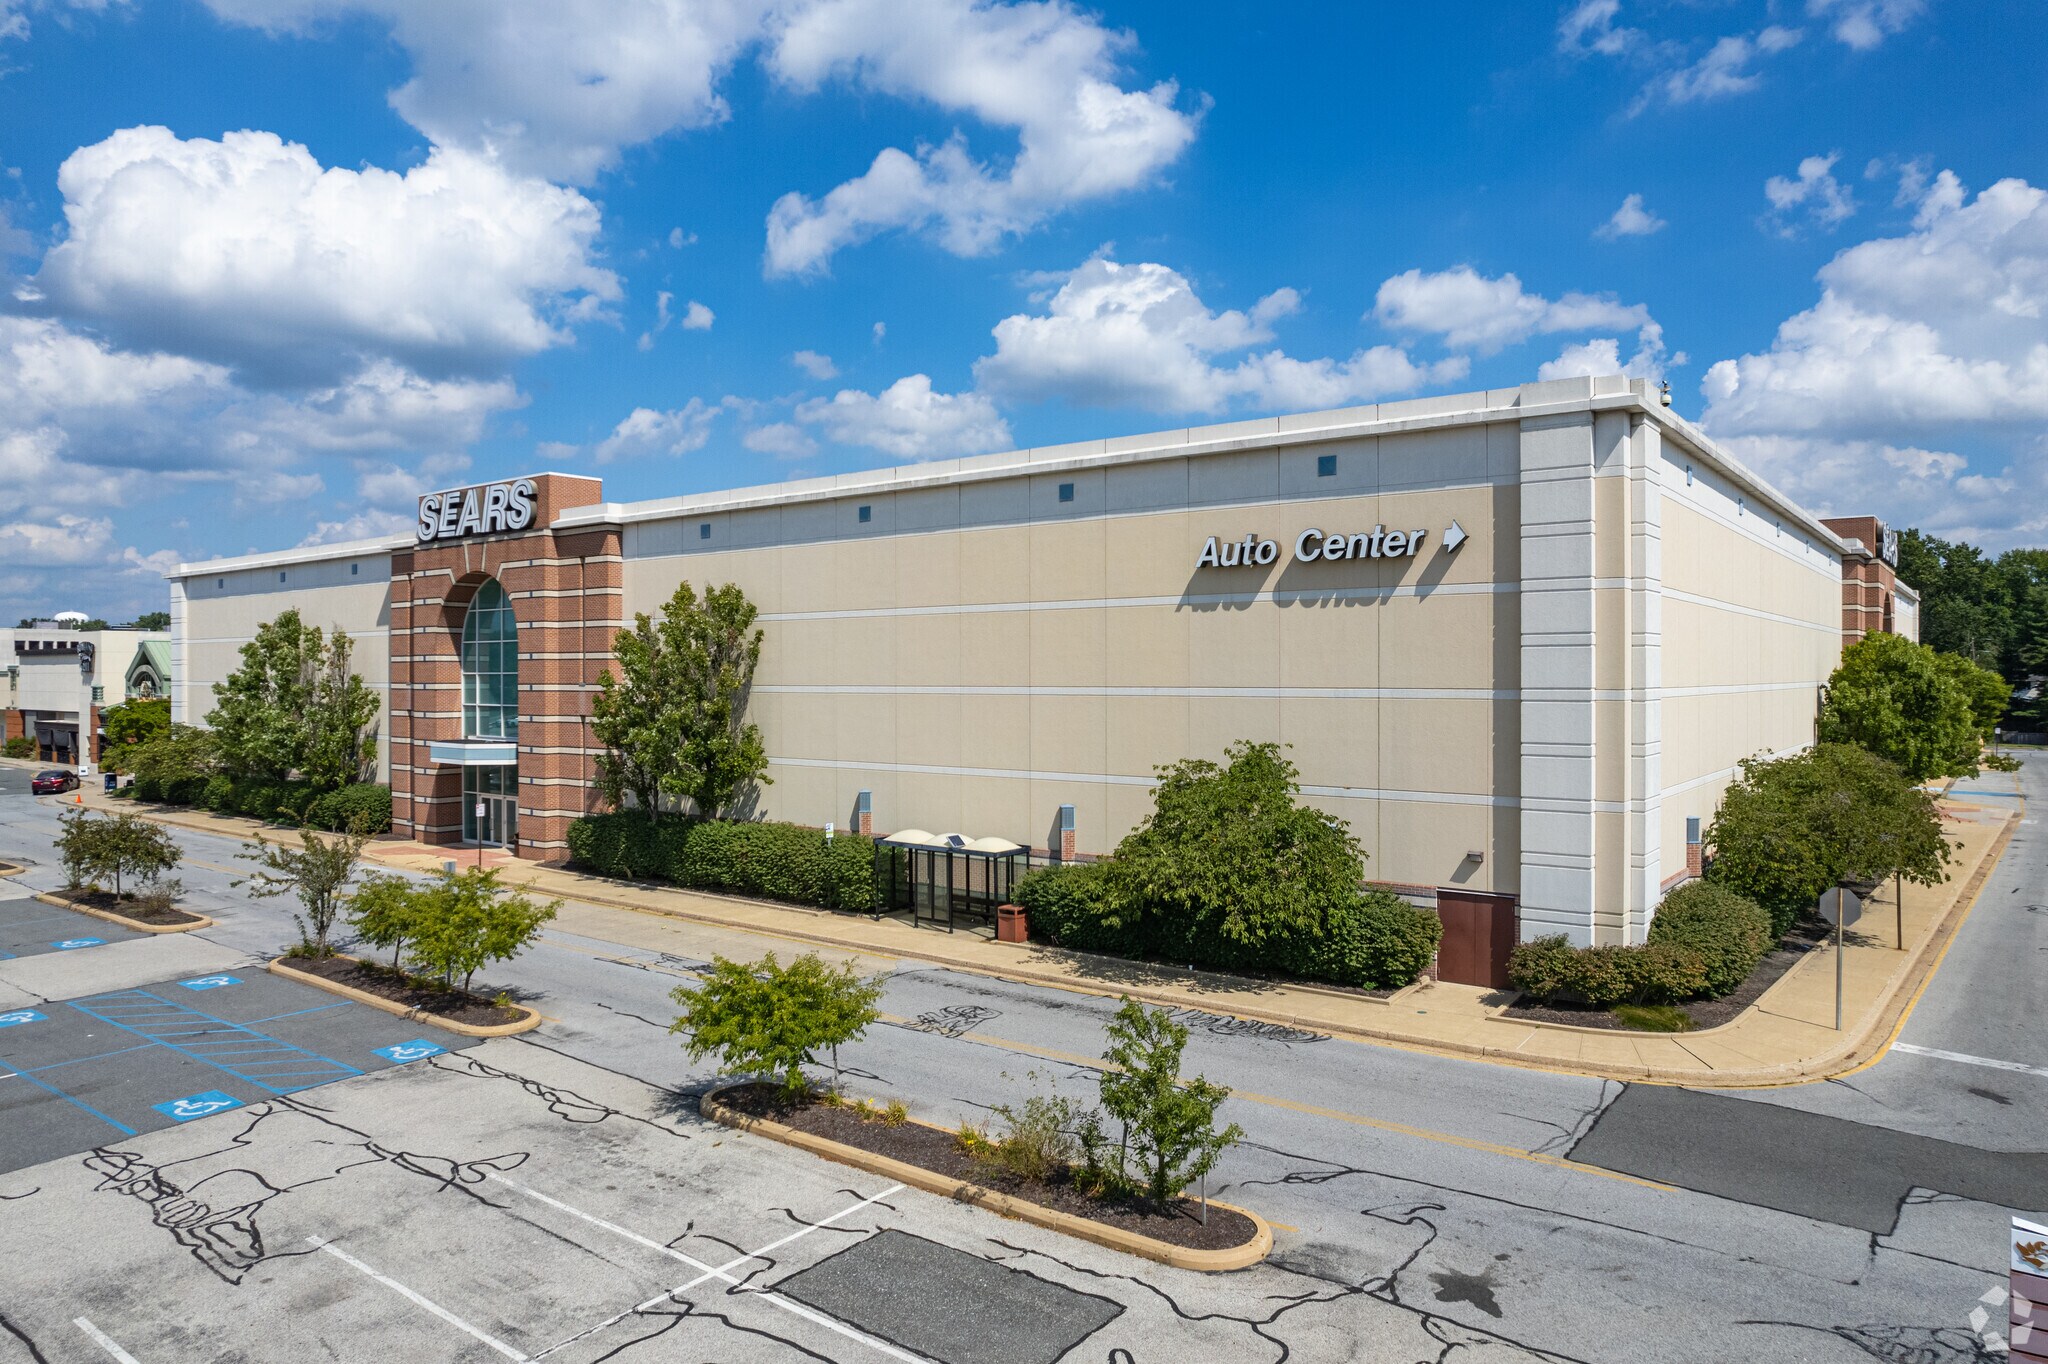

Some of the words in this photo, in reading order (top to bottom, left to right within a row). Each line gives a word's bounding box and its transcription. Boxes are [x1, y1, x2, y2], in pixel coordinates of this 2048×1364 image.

[417, 479, 538, 540] SEARS
[1195, 534, 1280, 568] Auto
[1294, 524, 1427, 562] Center
